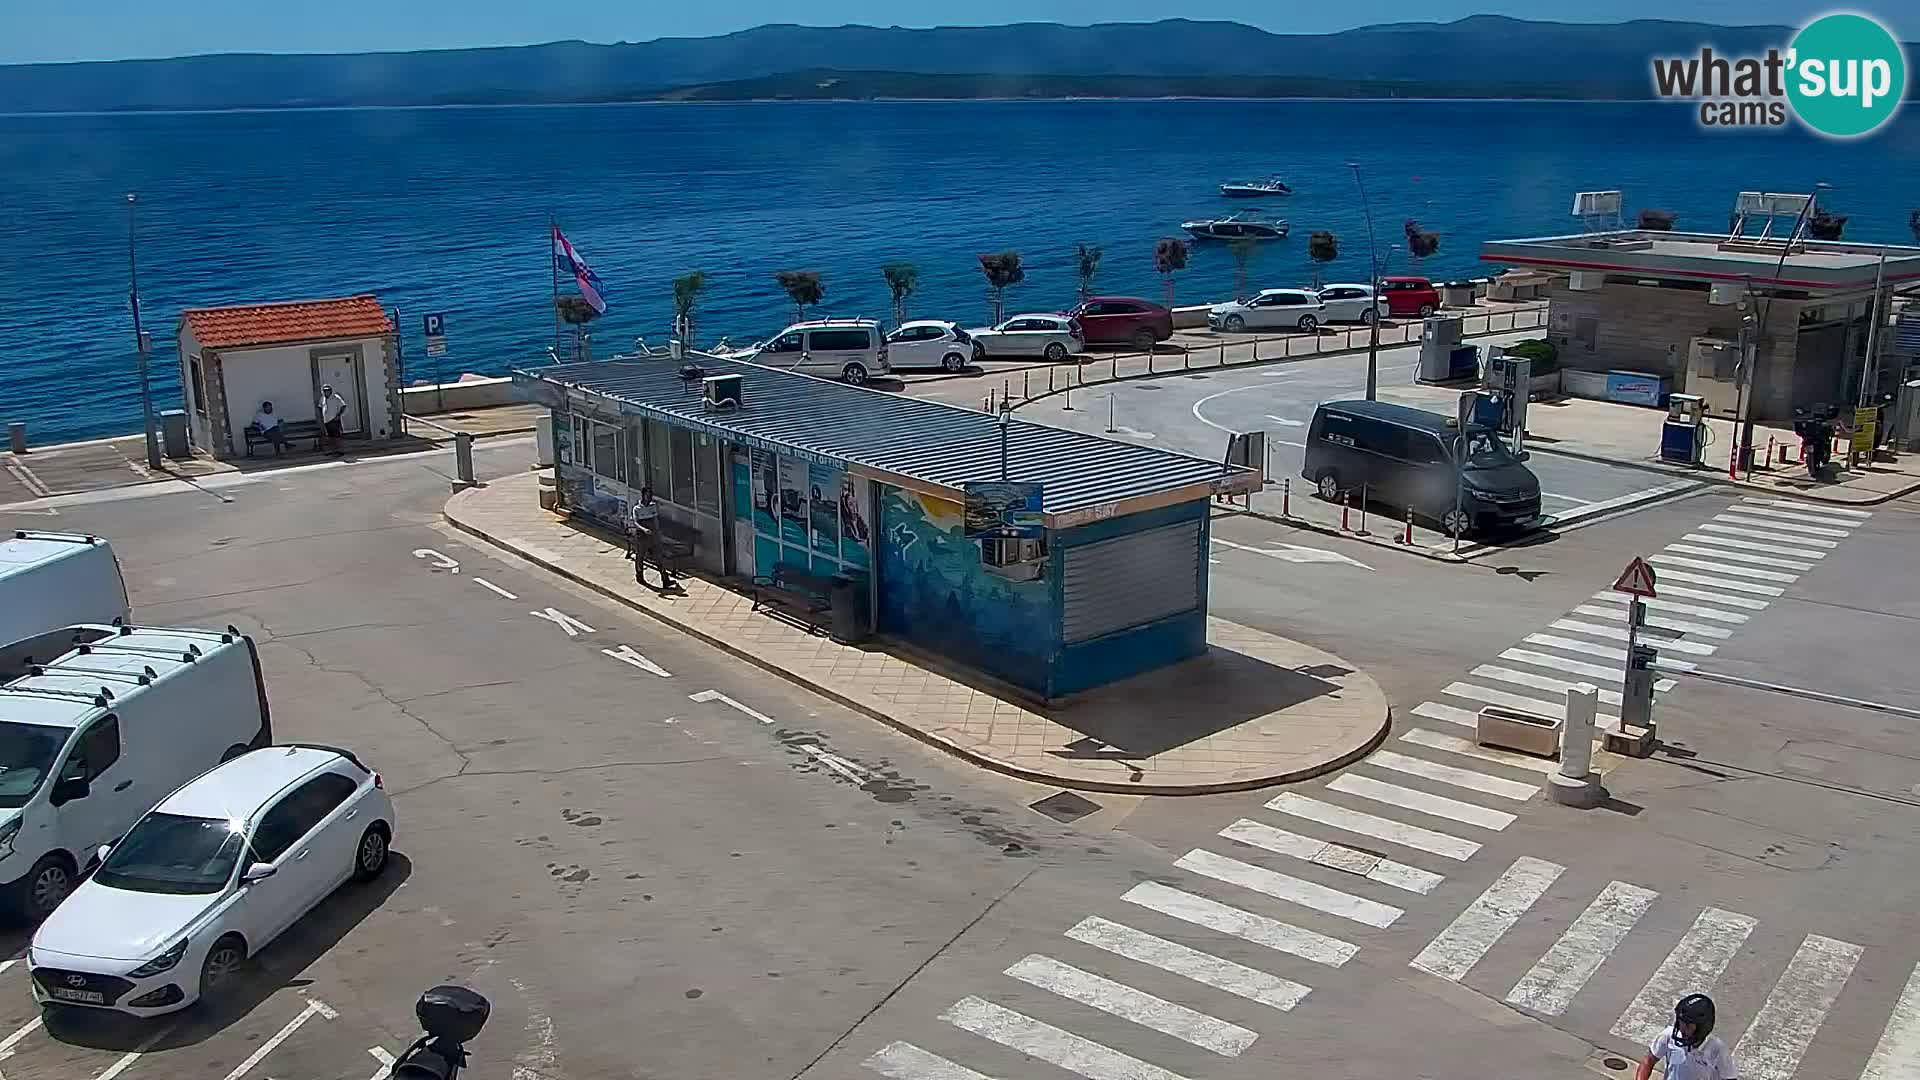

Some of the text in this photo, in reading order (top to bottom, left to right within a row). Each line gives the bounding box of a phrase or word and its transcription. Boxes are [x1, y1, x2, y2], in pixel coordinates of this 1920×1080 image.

[428, 316, 439, 333] P
[746, 435, 760, 449] BUS
[761, 440, 791, 456] STATION
[794, 448, 817, 463] TICKET
[819, 455, 845, 470] OFFICE
